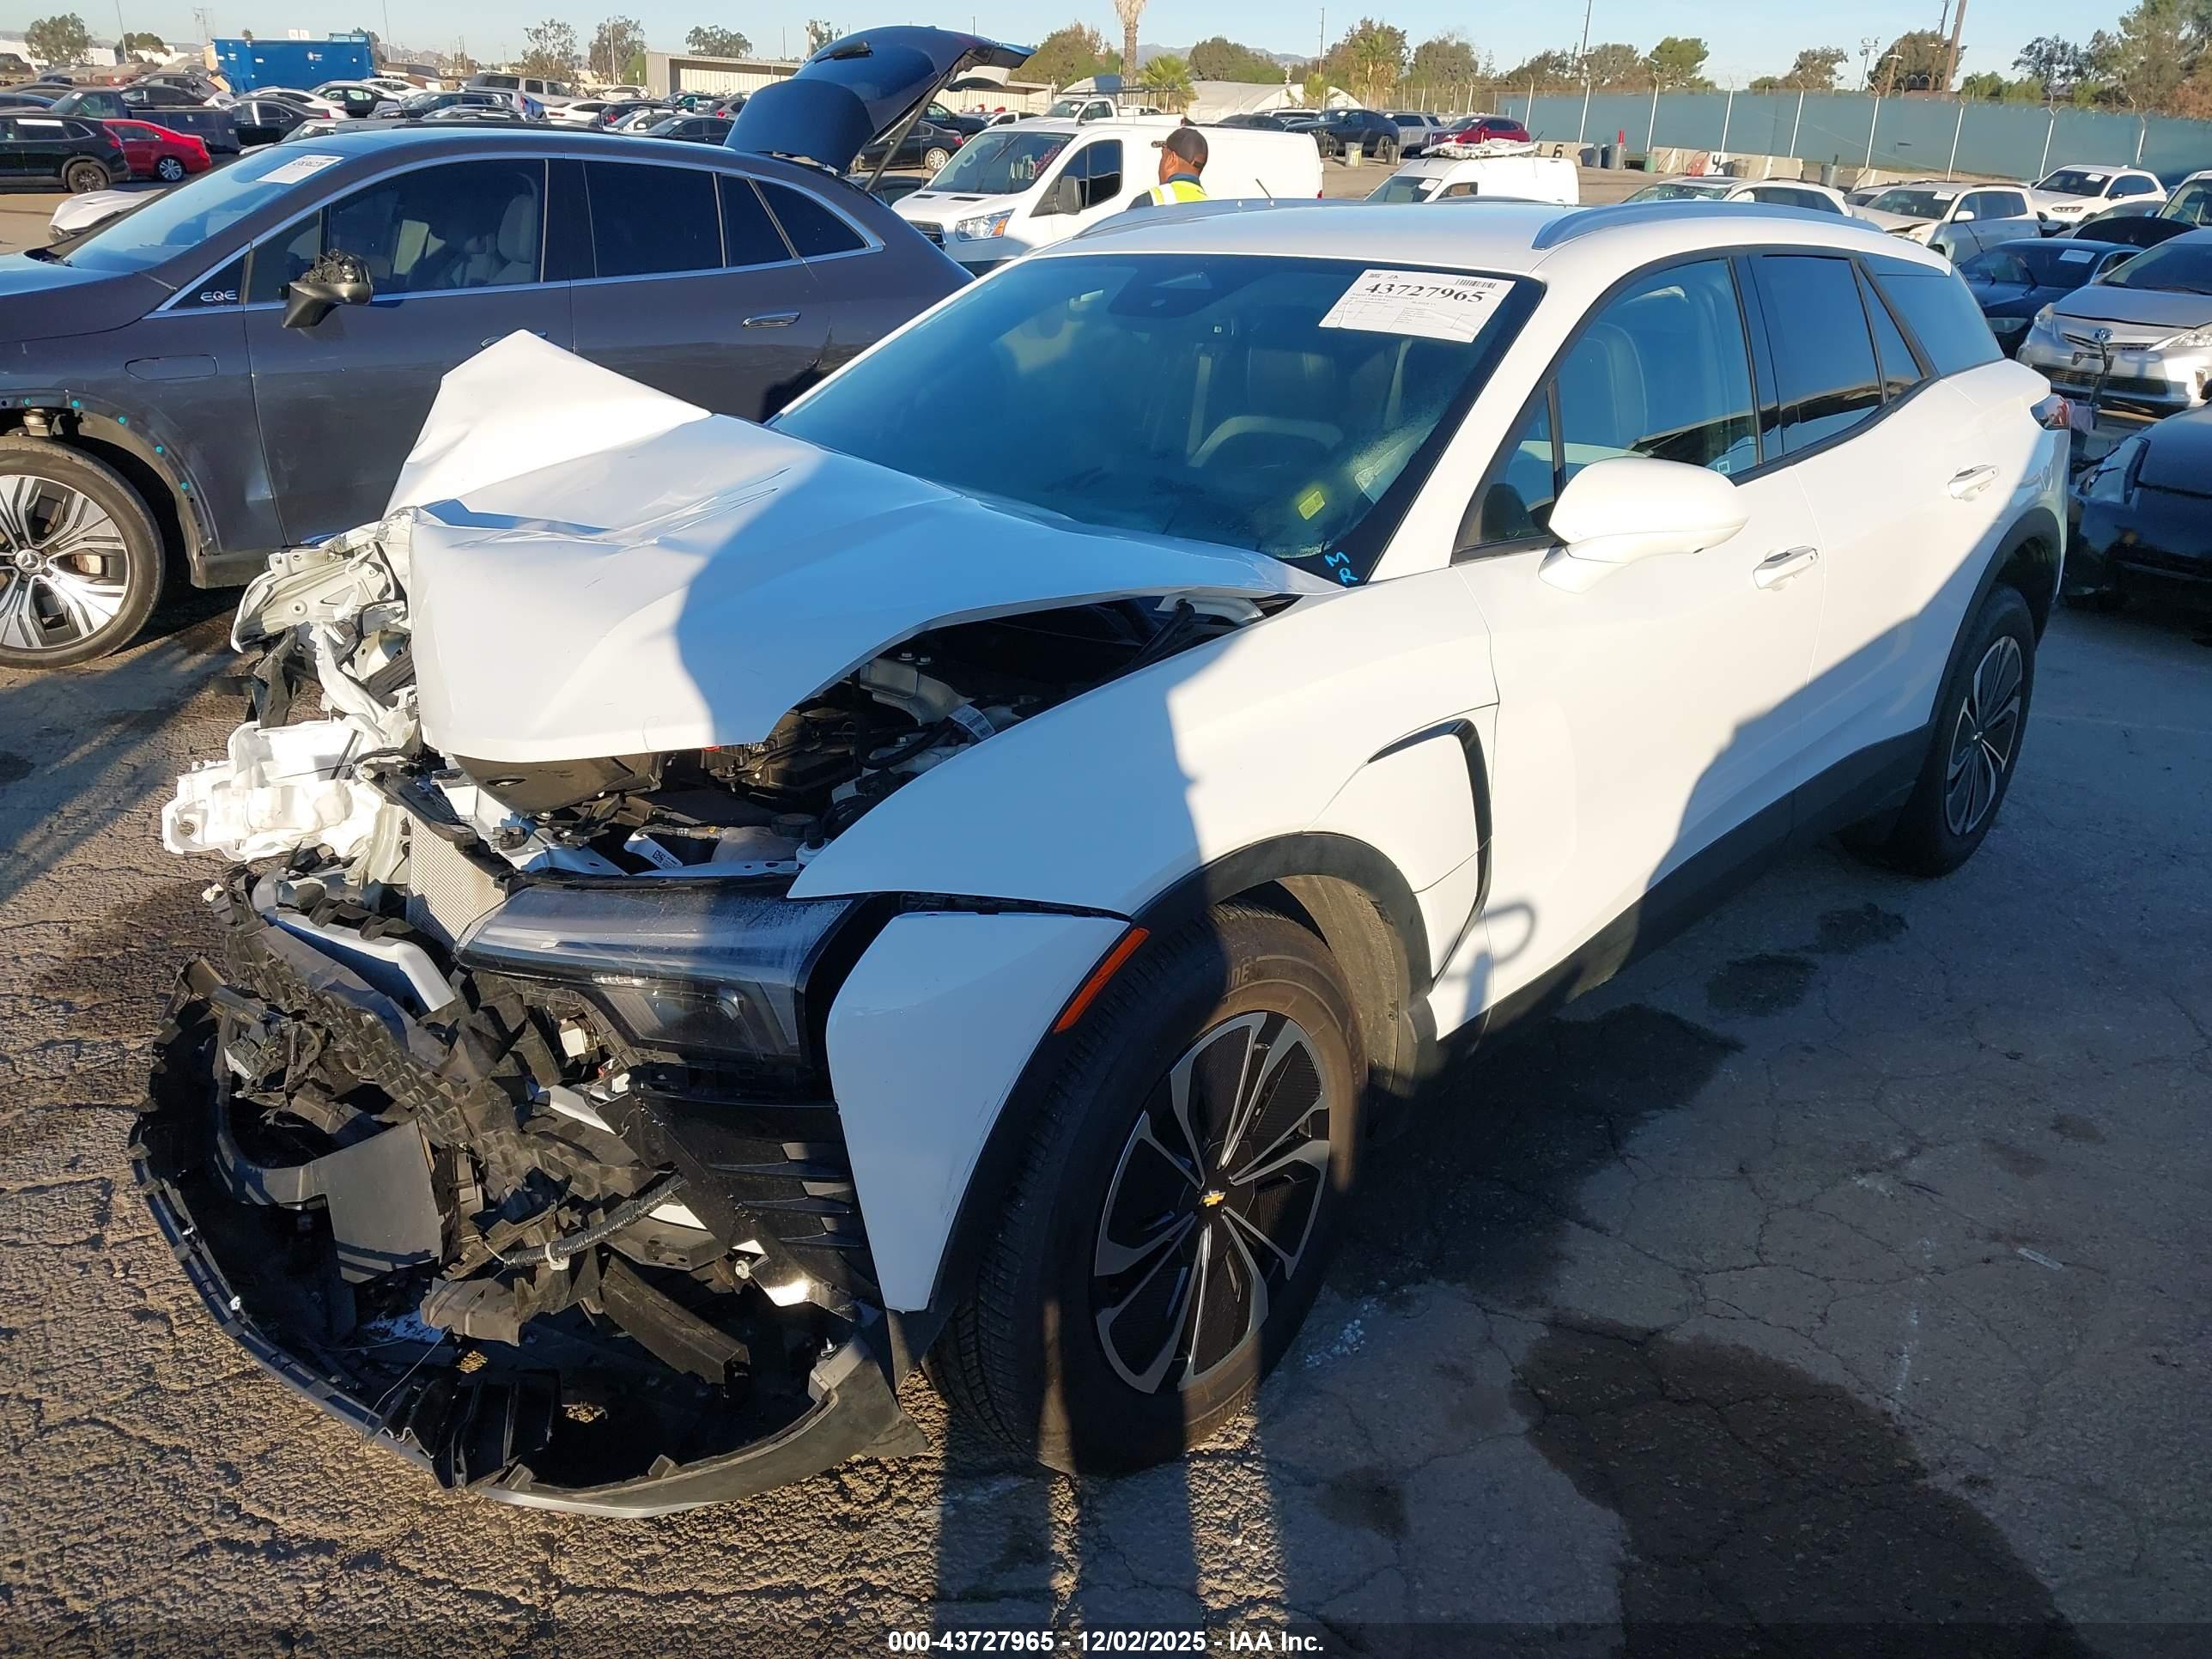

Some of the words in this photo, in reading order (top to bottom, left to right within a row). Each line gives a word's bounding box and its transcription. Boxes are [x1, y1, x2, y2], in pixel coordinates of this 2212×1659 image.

[1553, 144, 1564, 158] 6
[1712, 155, 1722, 173] 4
[200, 289, 238, 302] EQE
[1365, 283, 1486, 303] 43727965
